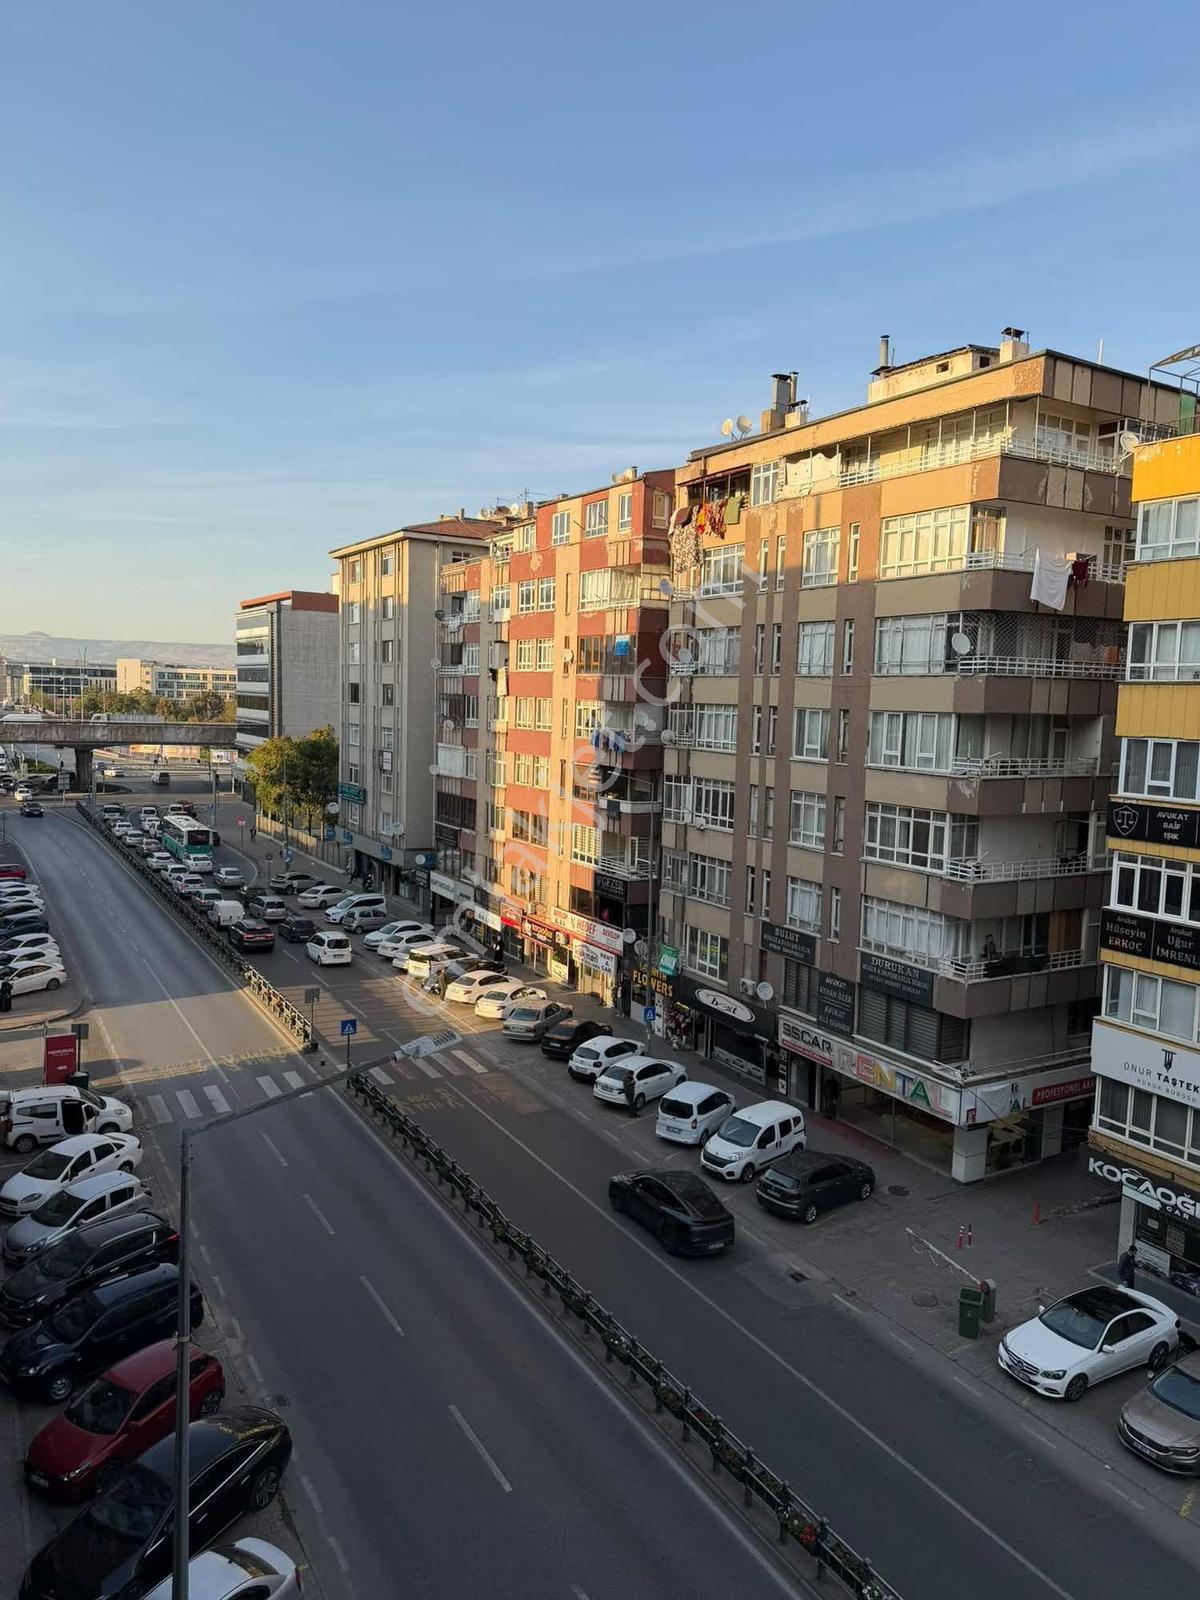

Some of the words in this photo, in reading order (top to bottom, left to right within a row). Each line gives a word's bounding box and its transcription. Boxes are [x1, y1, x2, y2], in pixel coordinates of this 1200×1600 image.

[1156, 811, 1190, 821] AVUKAT
[1116, 915, 1137, 926] Avukat
[1106, 922, 1147, 940] Hüseyin
[1169, 927, 1193, 938] Avukat
[1167, 934, 1194, 950] Uğur
[871, 956, 920, 979] DURUKAN
[632, 970, 673, 998] FLOWERS
[826, 977, 847, 989] AVUKAT
[782, 1022, 833, 1055] SSCAR
[838, 1048, 953, 1116] RENTAL
[1123, 1062, 1152, 1079] ONUR
[1156, 1072, 1200, 1095] TAŞTEK
[1136, 1078, 1162, 1091] HUKUK
[1166, 1205, 1191, 1221] CAR
